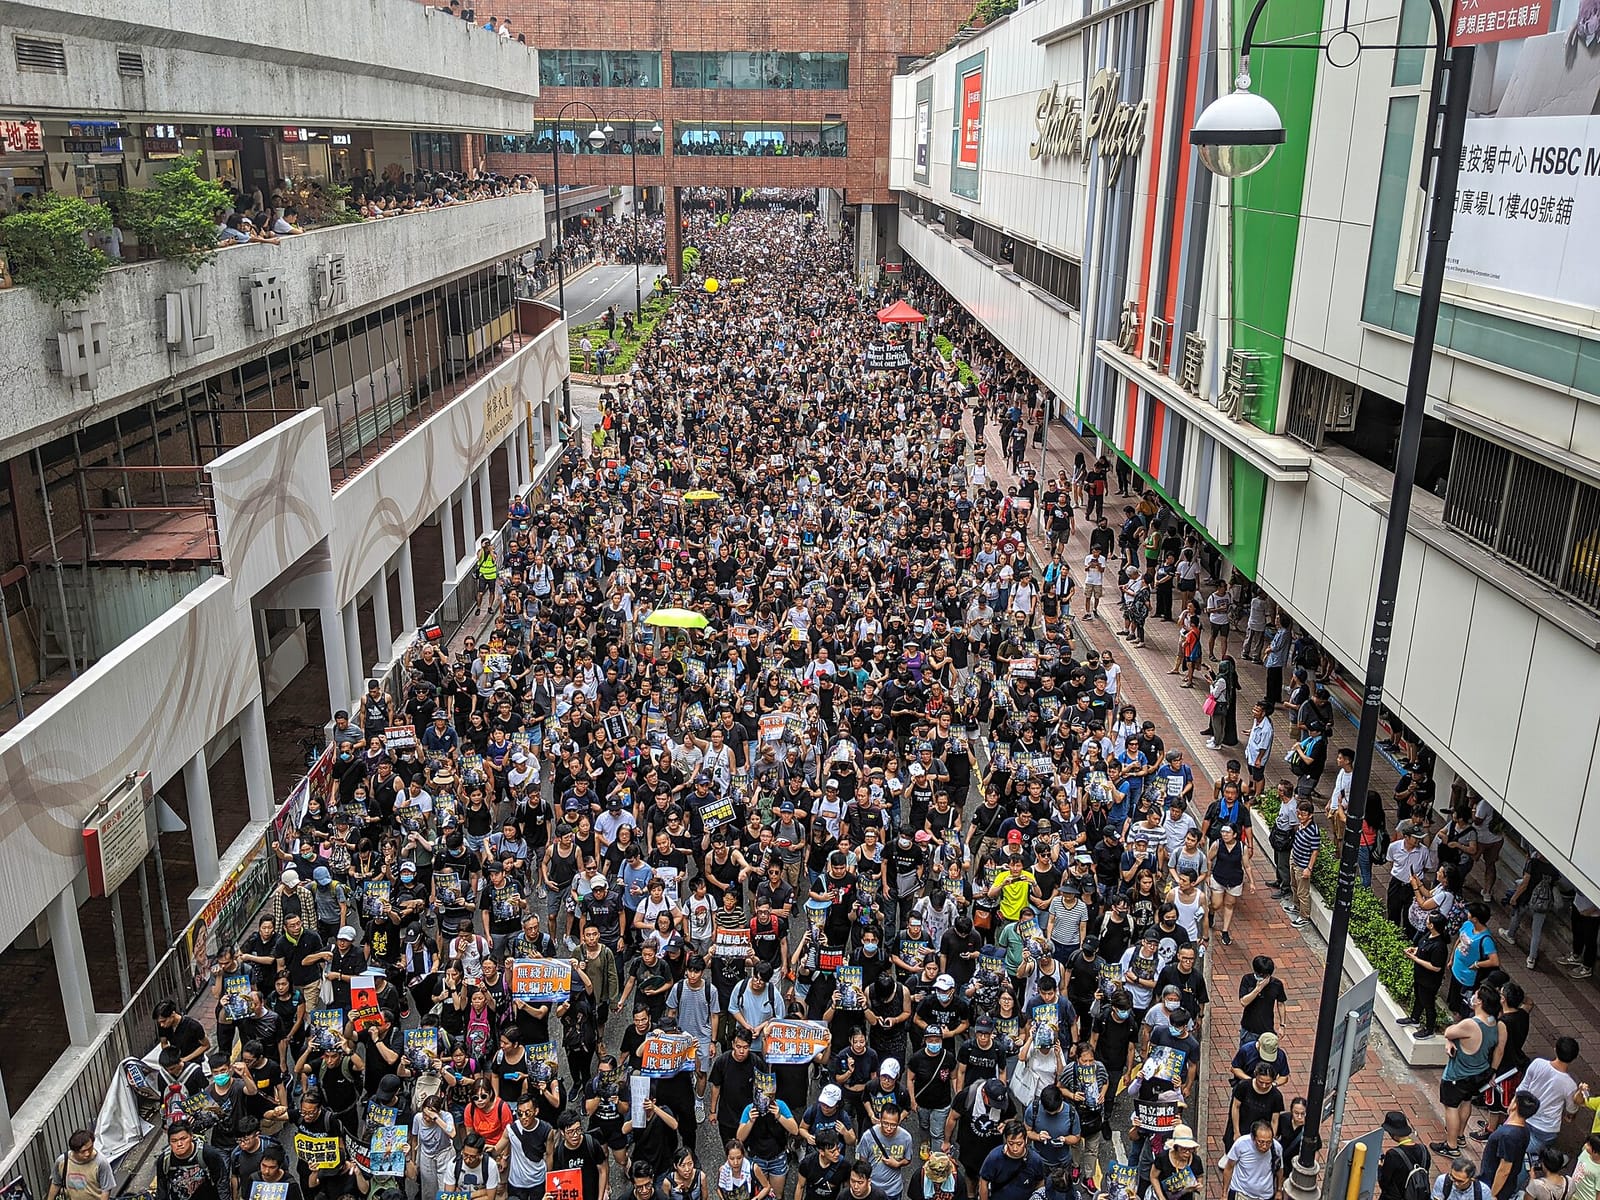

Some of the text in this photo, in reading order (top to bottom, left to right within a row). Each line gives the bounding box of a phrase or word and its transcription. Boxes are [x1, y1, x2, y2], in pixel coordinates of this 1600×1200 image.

[1456, 4, 1541, 37] 夢想居室已在眼前
[0, 119, 42, 151] 地產
[1082, 68, 1148, 188] Plaza
[1530, 146, 1582, 176] HSBC
[1583, 147, 1600, 177] M
[770, 1041, 810, 1055] 欺騙港
